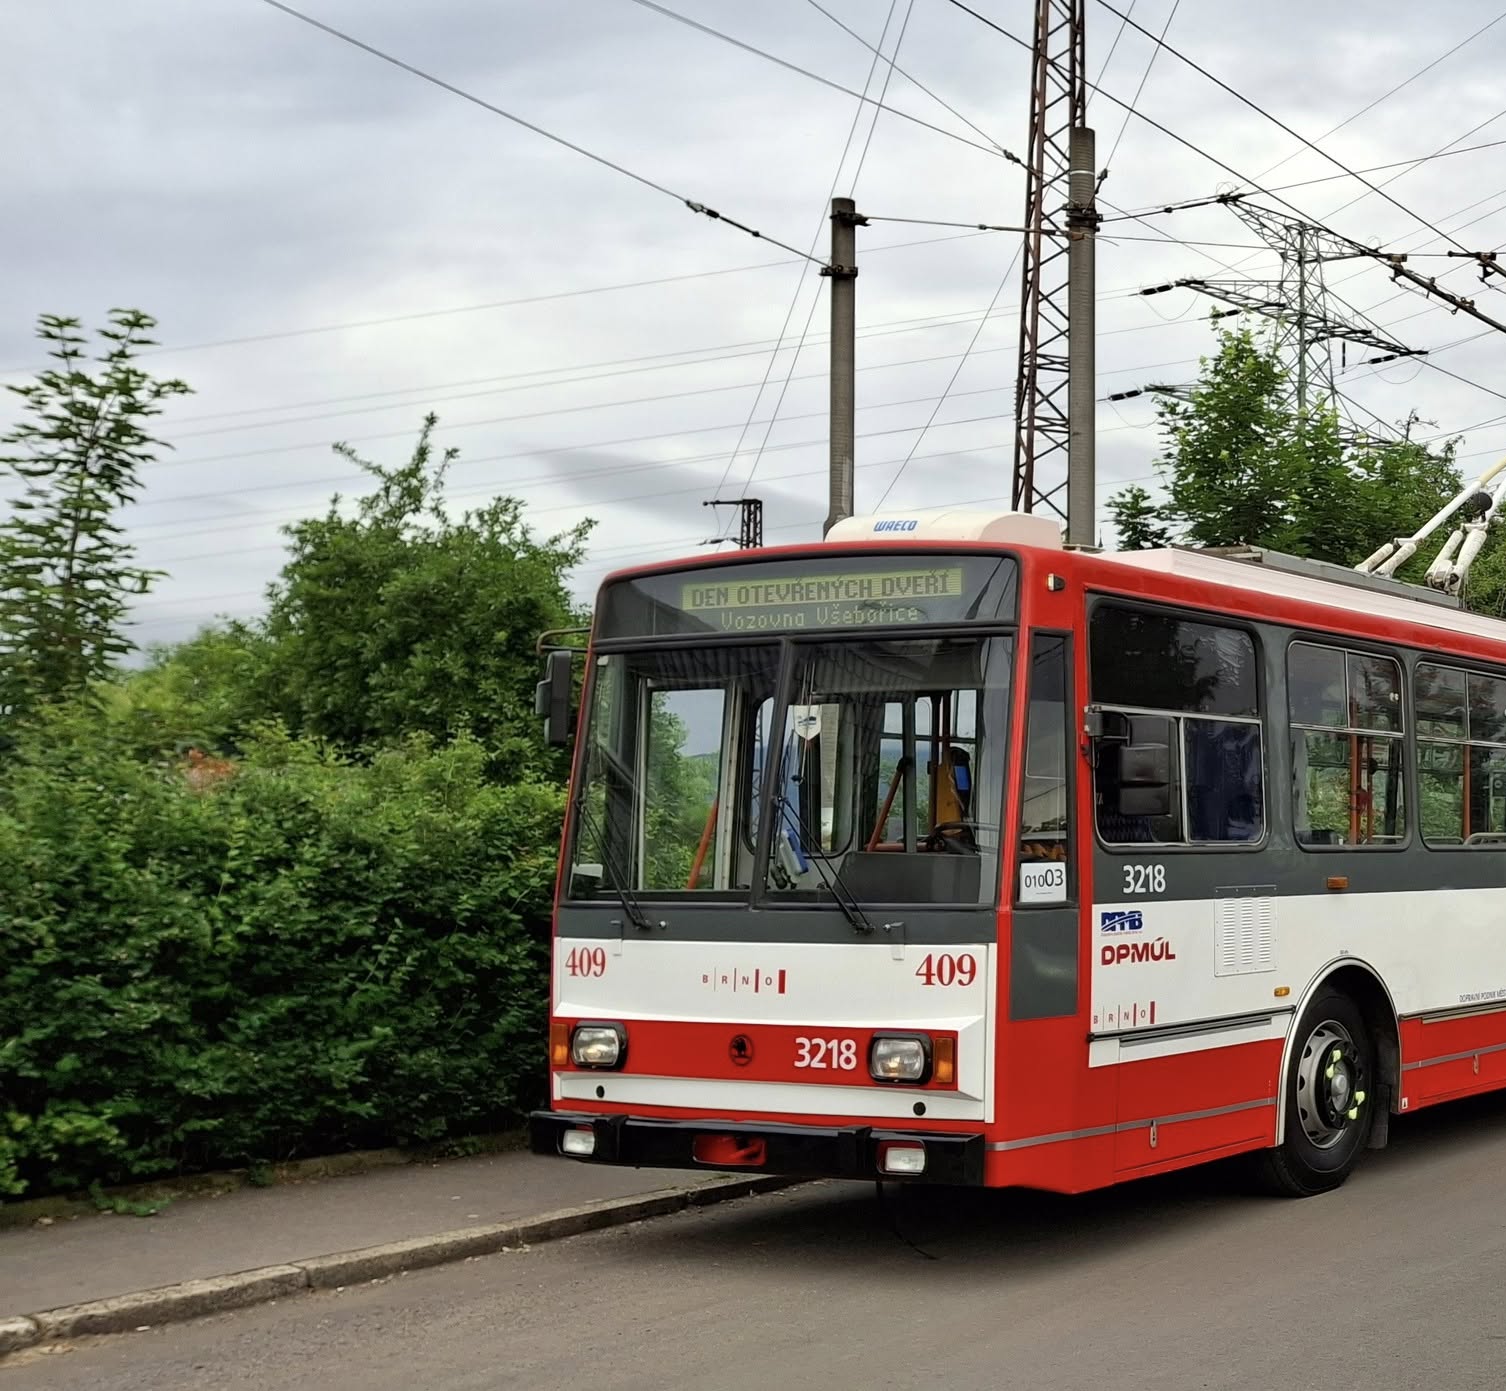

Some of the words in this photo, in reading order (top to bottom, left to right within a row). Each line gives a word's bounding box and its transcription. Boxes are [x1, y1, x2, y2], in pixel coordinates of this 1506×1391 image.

[874, 520, 918, 532] WAECO
[691, 586, 728, 607] DEN
[737, 575, 873, 605] OTEVŘENÝCH
[882, 569, 949, 597] DVEŘÍ
[720, 611, 805, 631] Vozovna
[816, 601, 919, 626] Všebořice
[1122, 864, 1166, 893] 3218
[565, 947, 606, 977] 409
[1101, 936, 1176, 966] DPMÚL
[915, 953, 977, 987] 409
[794, 1037, 857, 1070] 3218
